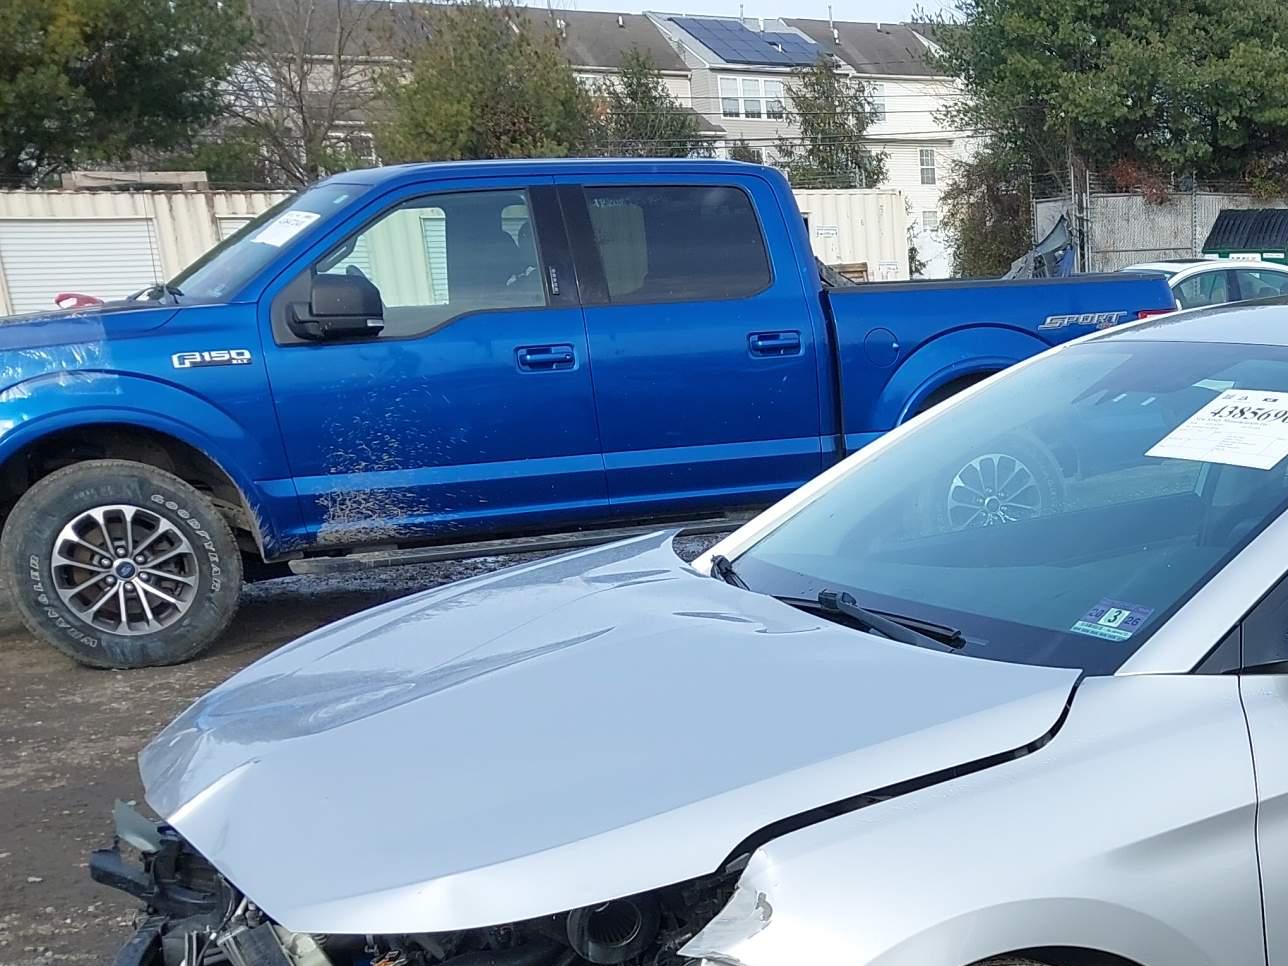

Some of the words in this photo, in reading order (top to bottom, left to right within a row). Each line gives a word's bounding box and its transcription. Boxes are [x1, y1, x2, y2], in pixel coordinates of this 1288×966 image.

[1038, 311, 1127, 330] SPORT
[151, 494, 222, 593] GOODYEAR
[28, 554, 98, 649] WRANGLER
[1107, 610, 1122, 623] 3
[1124, 616, 1141, 626] 26
